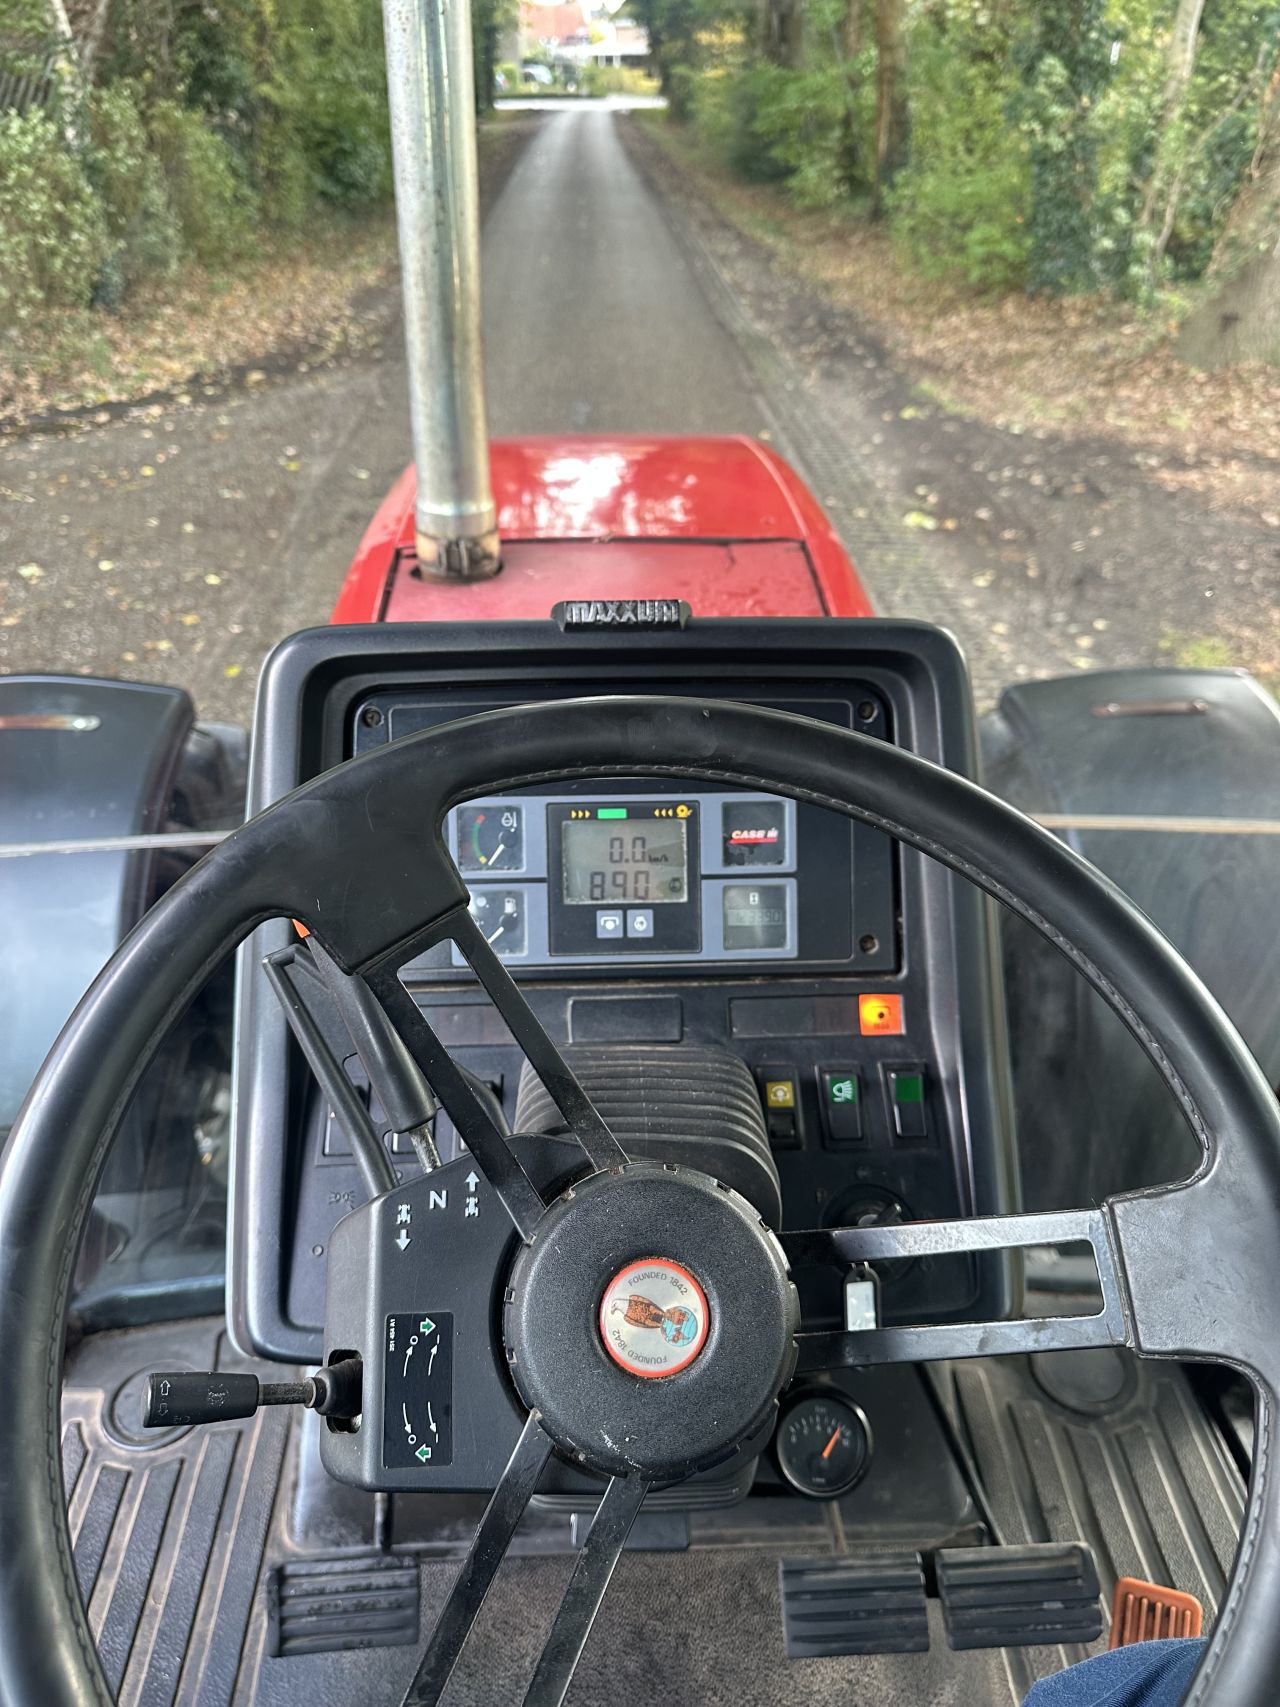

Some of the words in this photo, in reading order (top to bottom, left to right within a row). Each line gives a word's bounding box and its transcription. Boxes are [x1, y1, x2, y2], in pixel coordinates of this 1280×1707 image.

[566, 600, 680, 622] MAXXUM
[732, 830, 765, 839] CASE
[609, 837, 646, 863] 0.0
[589, 871, 650, 900] 890
[429, 1190, 447, 1209] N
[628, 1271, 667, 1286] FOUNDED
[669, 1276, 688, 1295] 1842
[612, 1329, 626, 1351] 1842
[627, 1350, 668, 1364] FOUNDED
